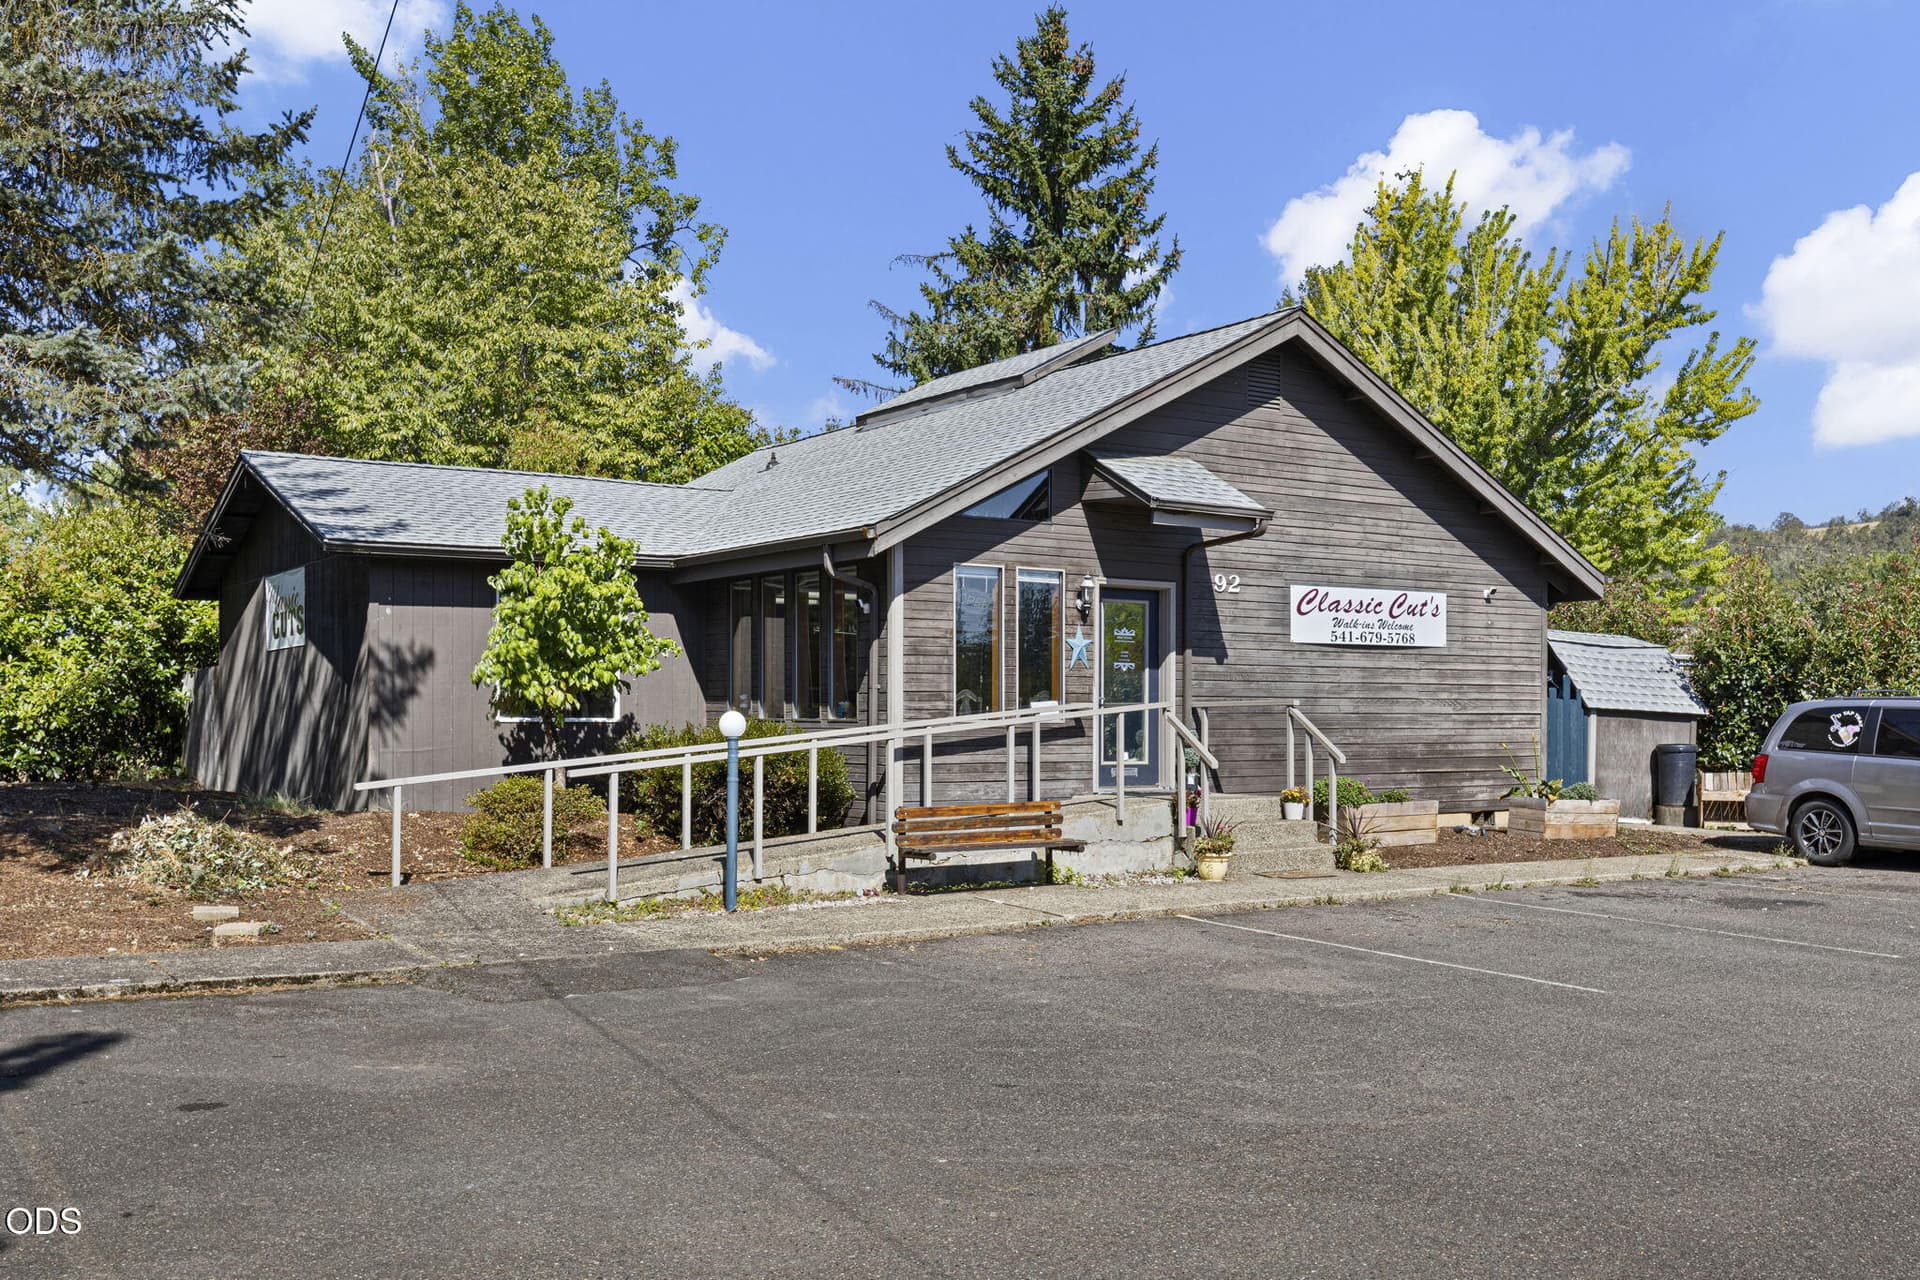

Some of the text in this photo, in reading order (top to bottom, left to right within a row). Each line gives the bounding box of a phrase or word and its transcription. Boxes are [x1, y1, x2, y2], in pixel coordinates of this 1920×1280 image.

[1214, 574, 1240, 593] 92
[1296, 588, 1441, 620] Classic Cut's
[272, 604, 304, 640] CUTS
[1332, 616, 1414, 632] Walk-ins Welcome
[1330, 630, 1416, 645] 541-679-5768
